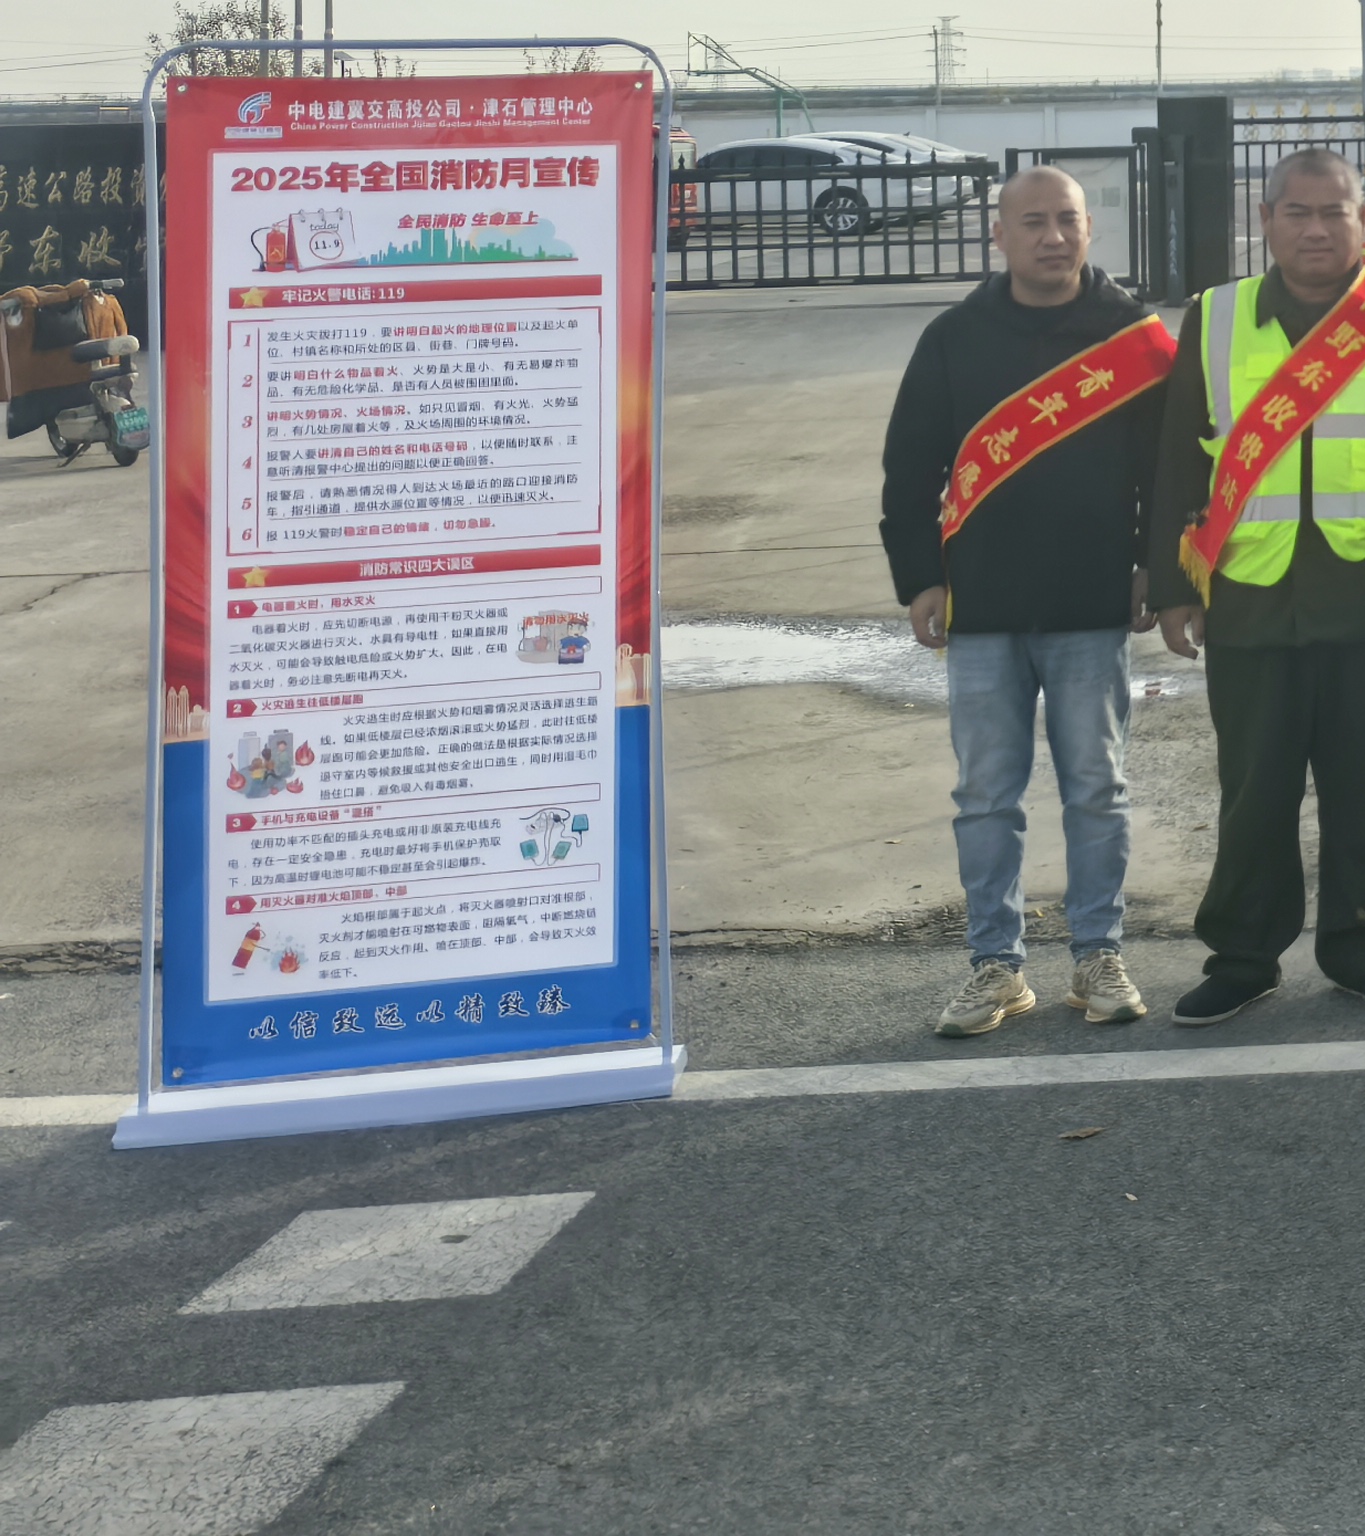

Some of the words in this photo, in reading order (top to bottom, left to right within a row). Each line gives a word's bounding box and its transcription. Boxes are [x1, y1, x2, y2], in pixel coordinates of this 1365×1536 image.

[290, 122, 316, 131] China
[319, 122, 349, 130] Power
[351, 120, 409, 129] Construction
[562, 117, 591, 125] Center
[230, 156, 600, 193] 2025年全国消防月宣传
[309, 220, 339, 232] today
[397, 213, 467, 230] 全民消防
[471, 210, 538, 227] 生命至上
[314, 239, 340, 251] 11.9
[282, 286, 405, 303] 牢记火警电话:119
[243, 334, 252, 347] 1
[242, 374, 252, 388] 2
[242, 415, 252, 428] 3
[242, 498, 252, 511] 5
[242, 528, 252, 541] 6
[359, 556, 475, 577] 消防常识四大误区
[234, 605, 241, 615] 1
[233, 704, 242, 714] 2
[232, 818, 242, 828] 3
